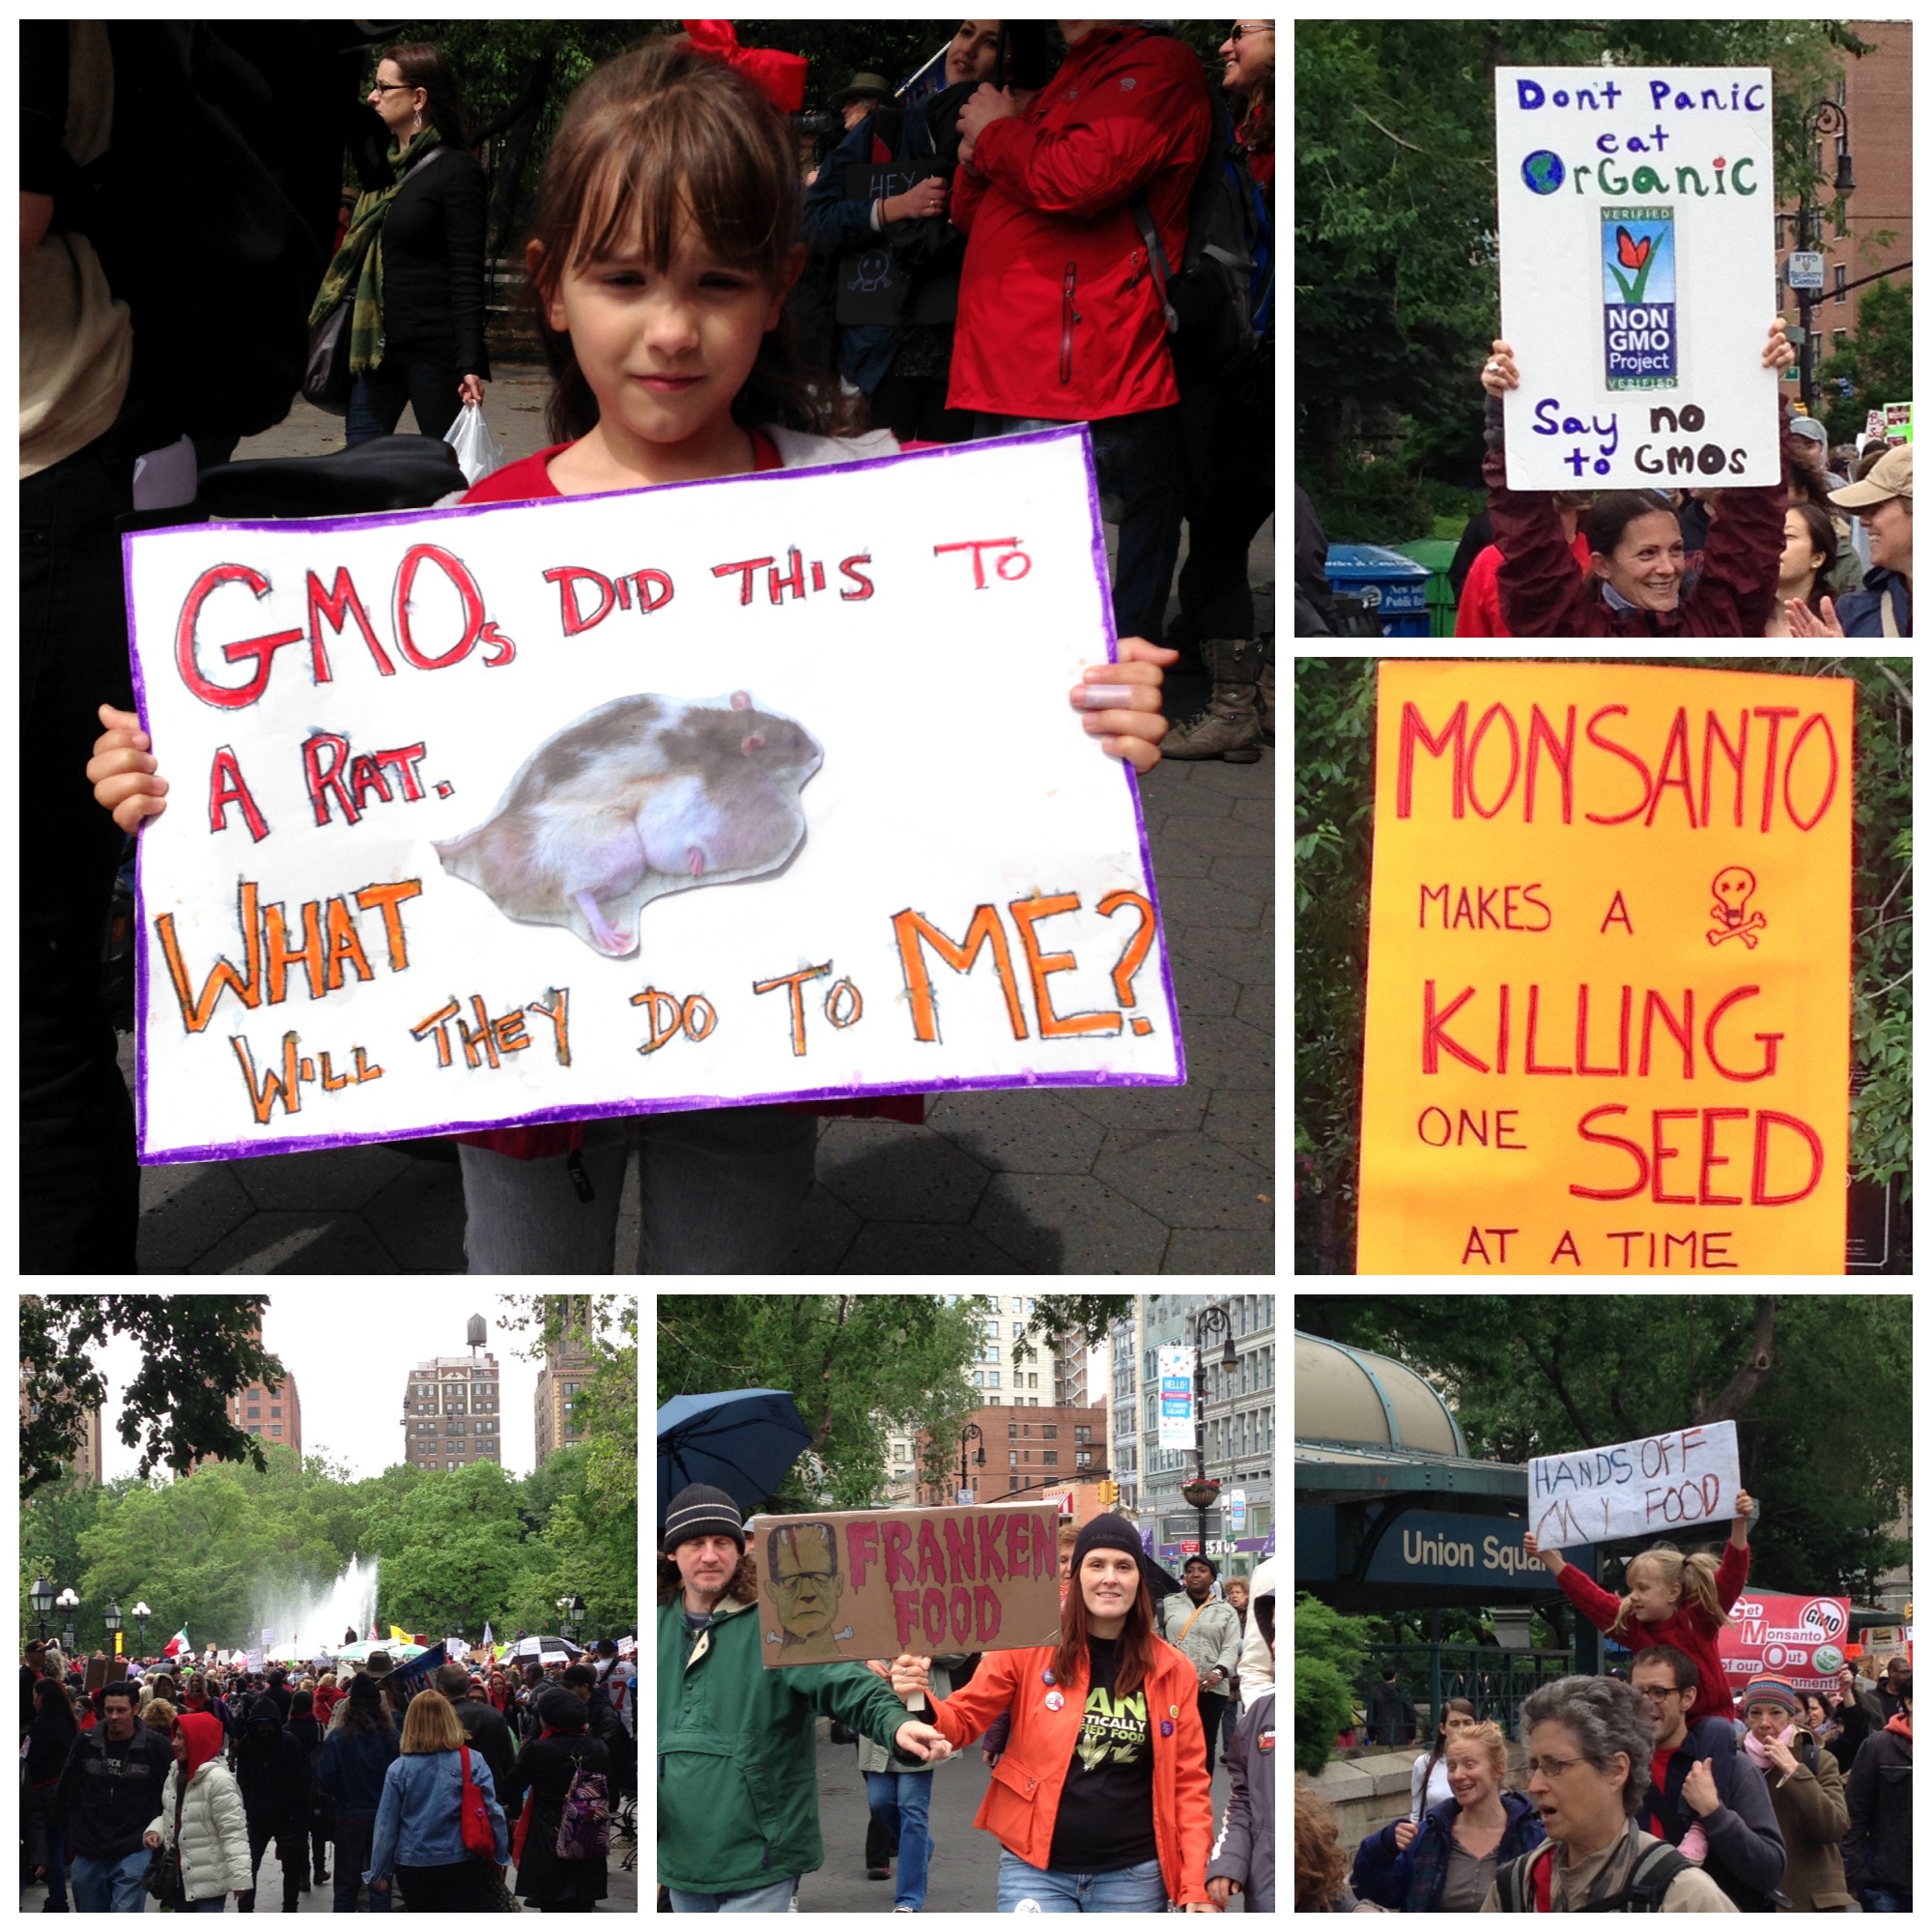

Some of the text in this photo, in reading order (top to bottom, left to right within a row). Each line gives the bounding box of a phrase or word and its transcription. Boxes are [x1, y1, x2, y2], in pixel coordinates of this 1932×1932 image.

[1596, 124, 1669, 154] eat
[869, 170, 916, 199] HEY
[1603, 209, 1670, 219] VERIFIED
[1609, 309, 1668, 329] NON
[1609, 330, 1670, 351] GMO
[1610, 353, 1669, 375] Project
[1608, 379, 1675, 388] VERIFIED
[1531, 398, 1705, 456] Say no
[1564, 448, 1611, 476] to
[174, 543, 517, 710] GMOs
[542, 566, 674, 638] DID
[710, 546, 875, 606] THIS
[1396, 699, 1838, 834] MONSANTO
[210, 745, 270, 842] A
[1419, 883, 1634, 935] MAKES A
[154, 879, 423, 1034] WHAT
[409, 985, 572, 1070] THEY
[630, 985, 717, 1055] DO
[891, 889, 1156, 1043] ME?
[1422, 979, 1785, 1082] KILLING
[1417, 1103, 1824, 1208] ONE SEED
[1462, 1226, 1739, 1268] AT A TIME
[1535, 1428, 1707, 1498] HANDS OFF
[1535, 1473, 1719, 1544] MY FOOD
[846, 1513, 1058, 1595] FRANKEN
[1403, 1529, 1562, 1576] Union Squa
[893, 1584, 1002, 1652] FOOD
[1727, 1598, 1760, 1623] Get
[1805, 1608, 1840, 1633] GMO
[1743, 1620, 1822, 1643] Monsanto
[1721, 1660, 1760, 1672] of our
[1763, 1643, 1802, 1669] Out
[1084, 1687, 1148, 1721] AN
[1079, 1724, 1107, 1737] FIED
[1110, 1728, 1147, 1743] FOOD
[1081, 1715, 1147, 1733] ETICALLY
